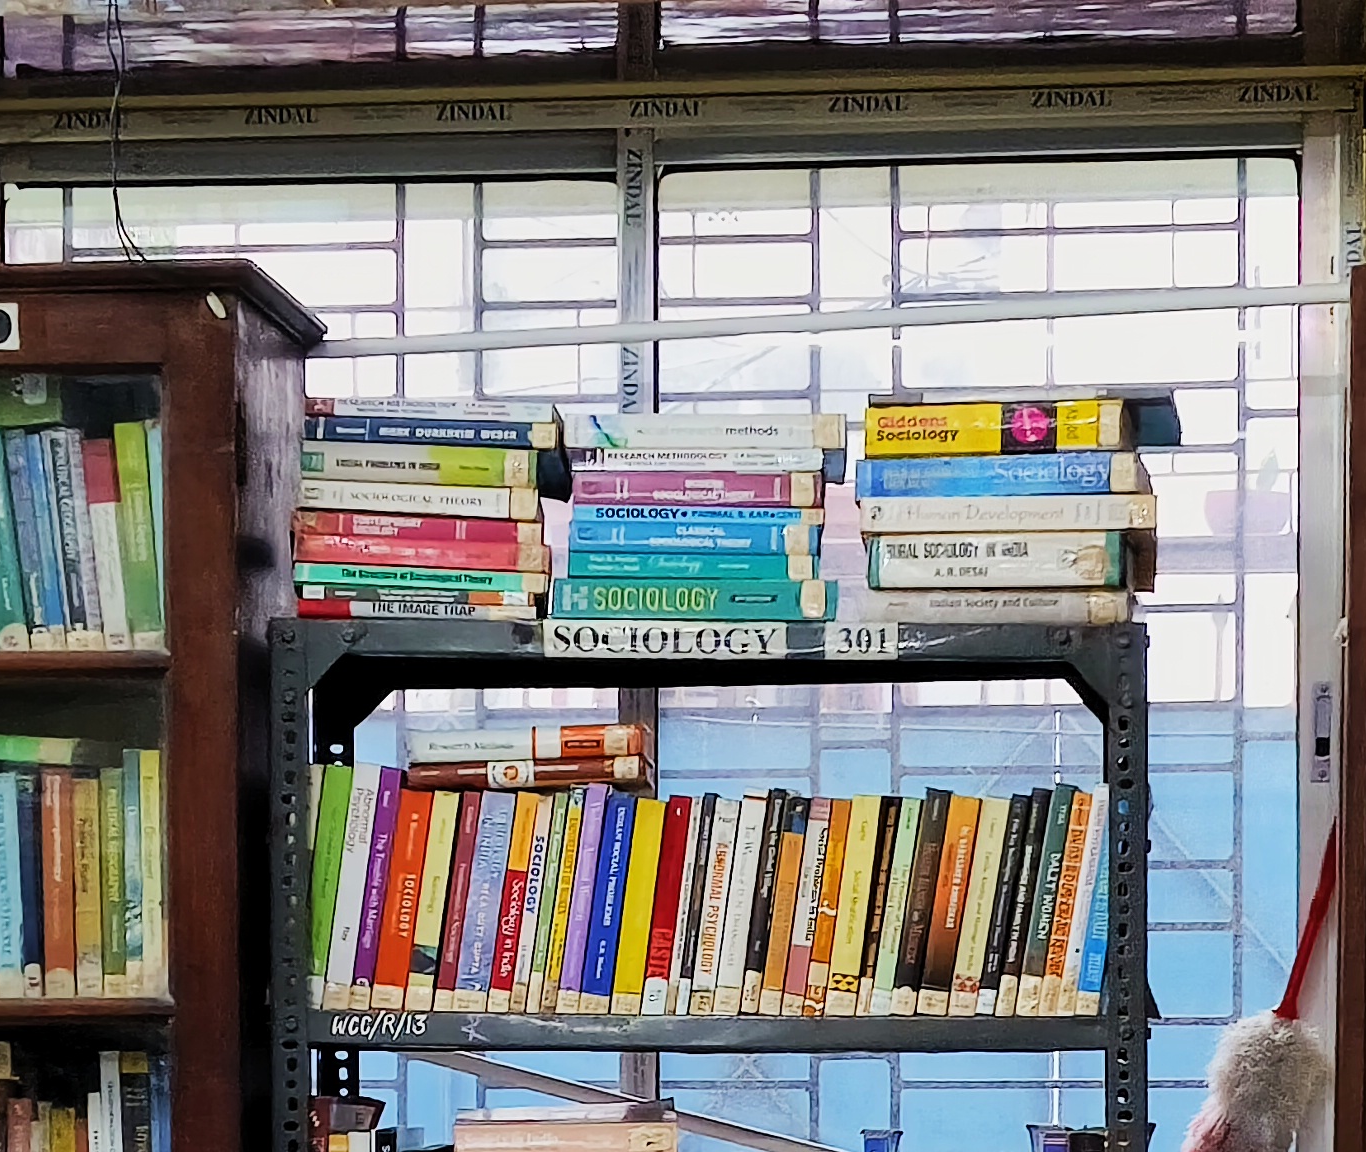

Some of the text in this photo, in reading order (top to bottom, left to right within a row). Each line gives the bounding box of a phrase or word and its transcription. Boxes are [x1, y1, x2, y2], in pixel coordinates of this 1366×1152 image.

[828, 91, 909, 114] ZINDAL
[1031, 87, 1114, 111] ZINDAL
[1238, 82, 1321, 105] ZINDAL
[243, 106, 319, 127] ZINDAL
[435, 101, 513, 123] ZINDAL
[628, 97, 705, 120] ZINDAL
[625, 148, 644, 227] ZINDAL
[726, 425, 779, 437] methods
[876, 415, 948, 429] Giddens
[876, 428, 960, 443] Sociology
[607, 451, 729, 461] RESEARCH METHODOLOGY
[992, 455, 1110, 488] Sociology
[349, 491, 483, 507] SOCIOLOGICAL THEORY
[595, 506, 680, 520] SOCIOLOGY
[906, 502, 1065, 523] Human Development
[923, 543, 979, 559] SOCIOLOGY
[371, 601, 439, 615] THE IMAGE
[593, 585, 718, 611] SOCIOLOGY
[963, 598, 1020, 609] Society and
[553, 625, 780, 657] SOCIOLOGY
[836, 627, 888, 654] 301
[346, 787, 364, 854] Psychology
[358, 788, 376, 846] Abnormal
[614, 806, 628, 840] INDIAN
[376, 833, 388, 851] The
[609, 841, 622, 875] SOCIAL
[525, 835, 545, 915] SOCIOLOGY
[398, 873, 417, 940] SOCIOLOGY
[501, 878, 525, 937] Sociology
[1036, 852, 1063, 941] DALIT WOMEN
[699, 842, 729, 976] ABNORMAL PSYCHOLOGY
[647, 927, 673, 981] CASTE
[330, 1010, 428, 1041] WCC/R/13
